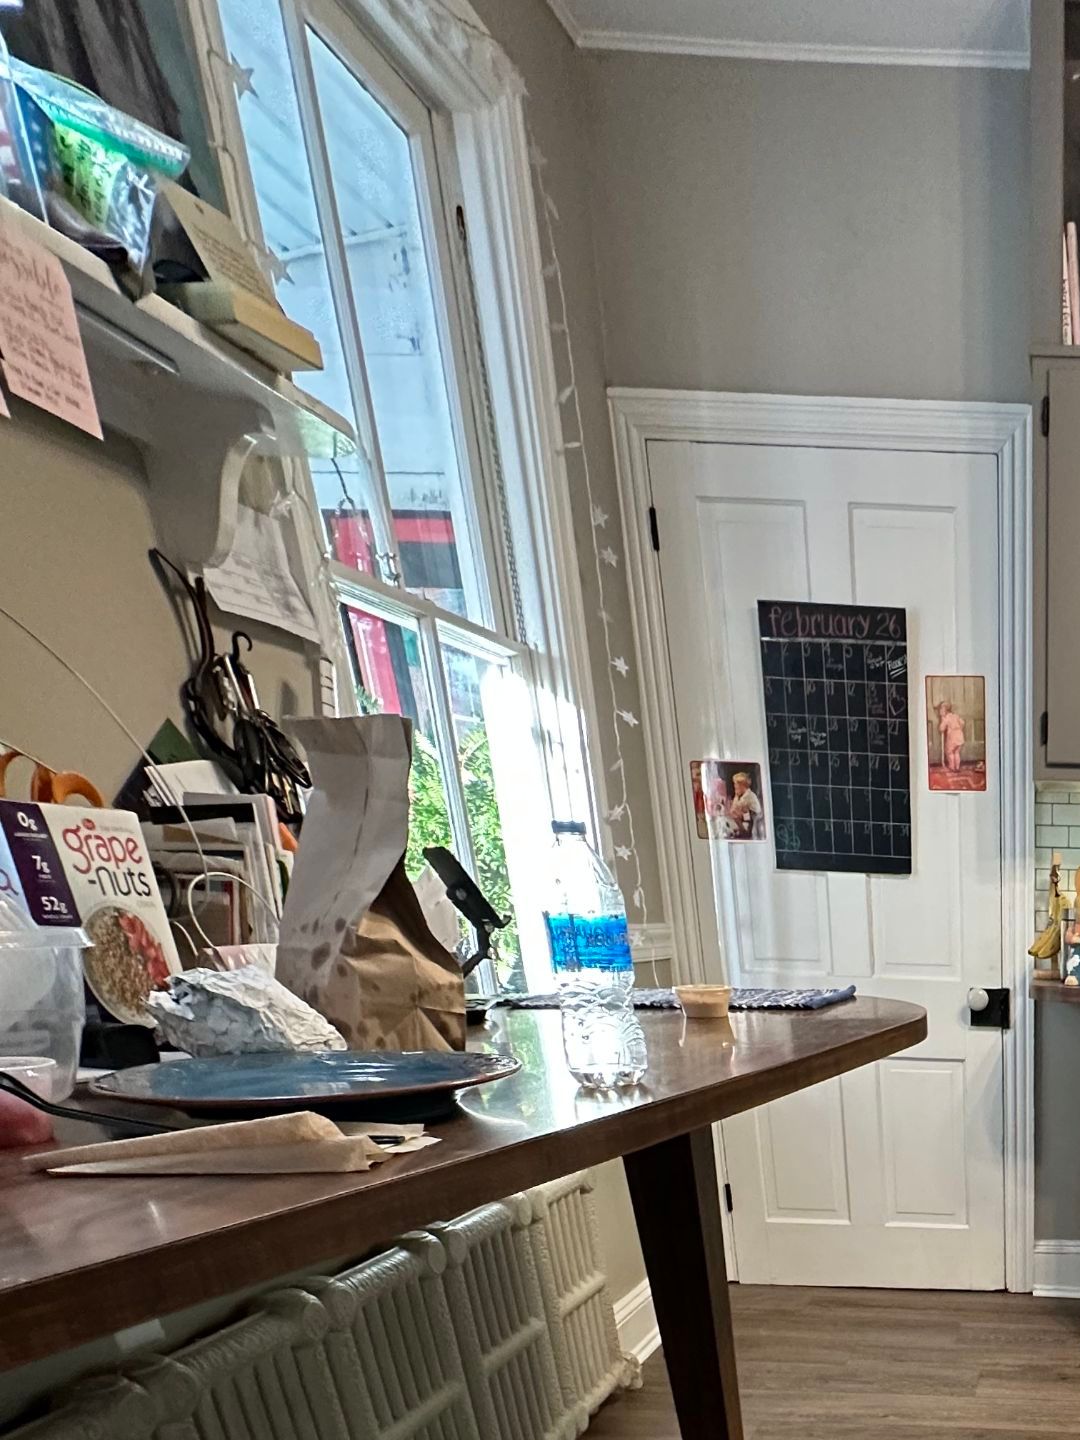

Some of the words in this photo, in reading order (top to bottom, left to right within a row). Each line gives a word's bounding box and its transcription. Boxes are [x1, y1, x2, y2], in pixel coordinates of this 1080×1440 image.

[875, 612, 901, 639] 26
[16, 811, 39, 831] 0g
[62, 824, 143, 875] grape
[31, 854, 51, 874] 7g
[41, 895, 69, 914] 52g
